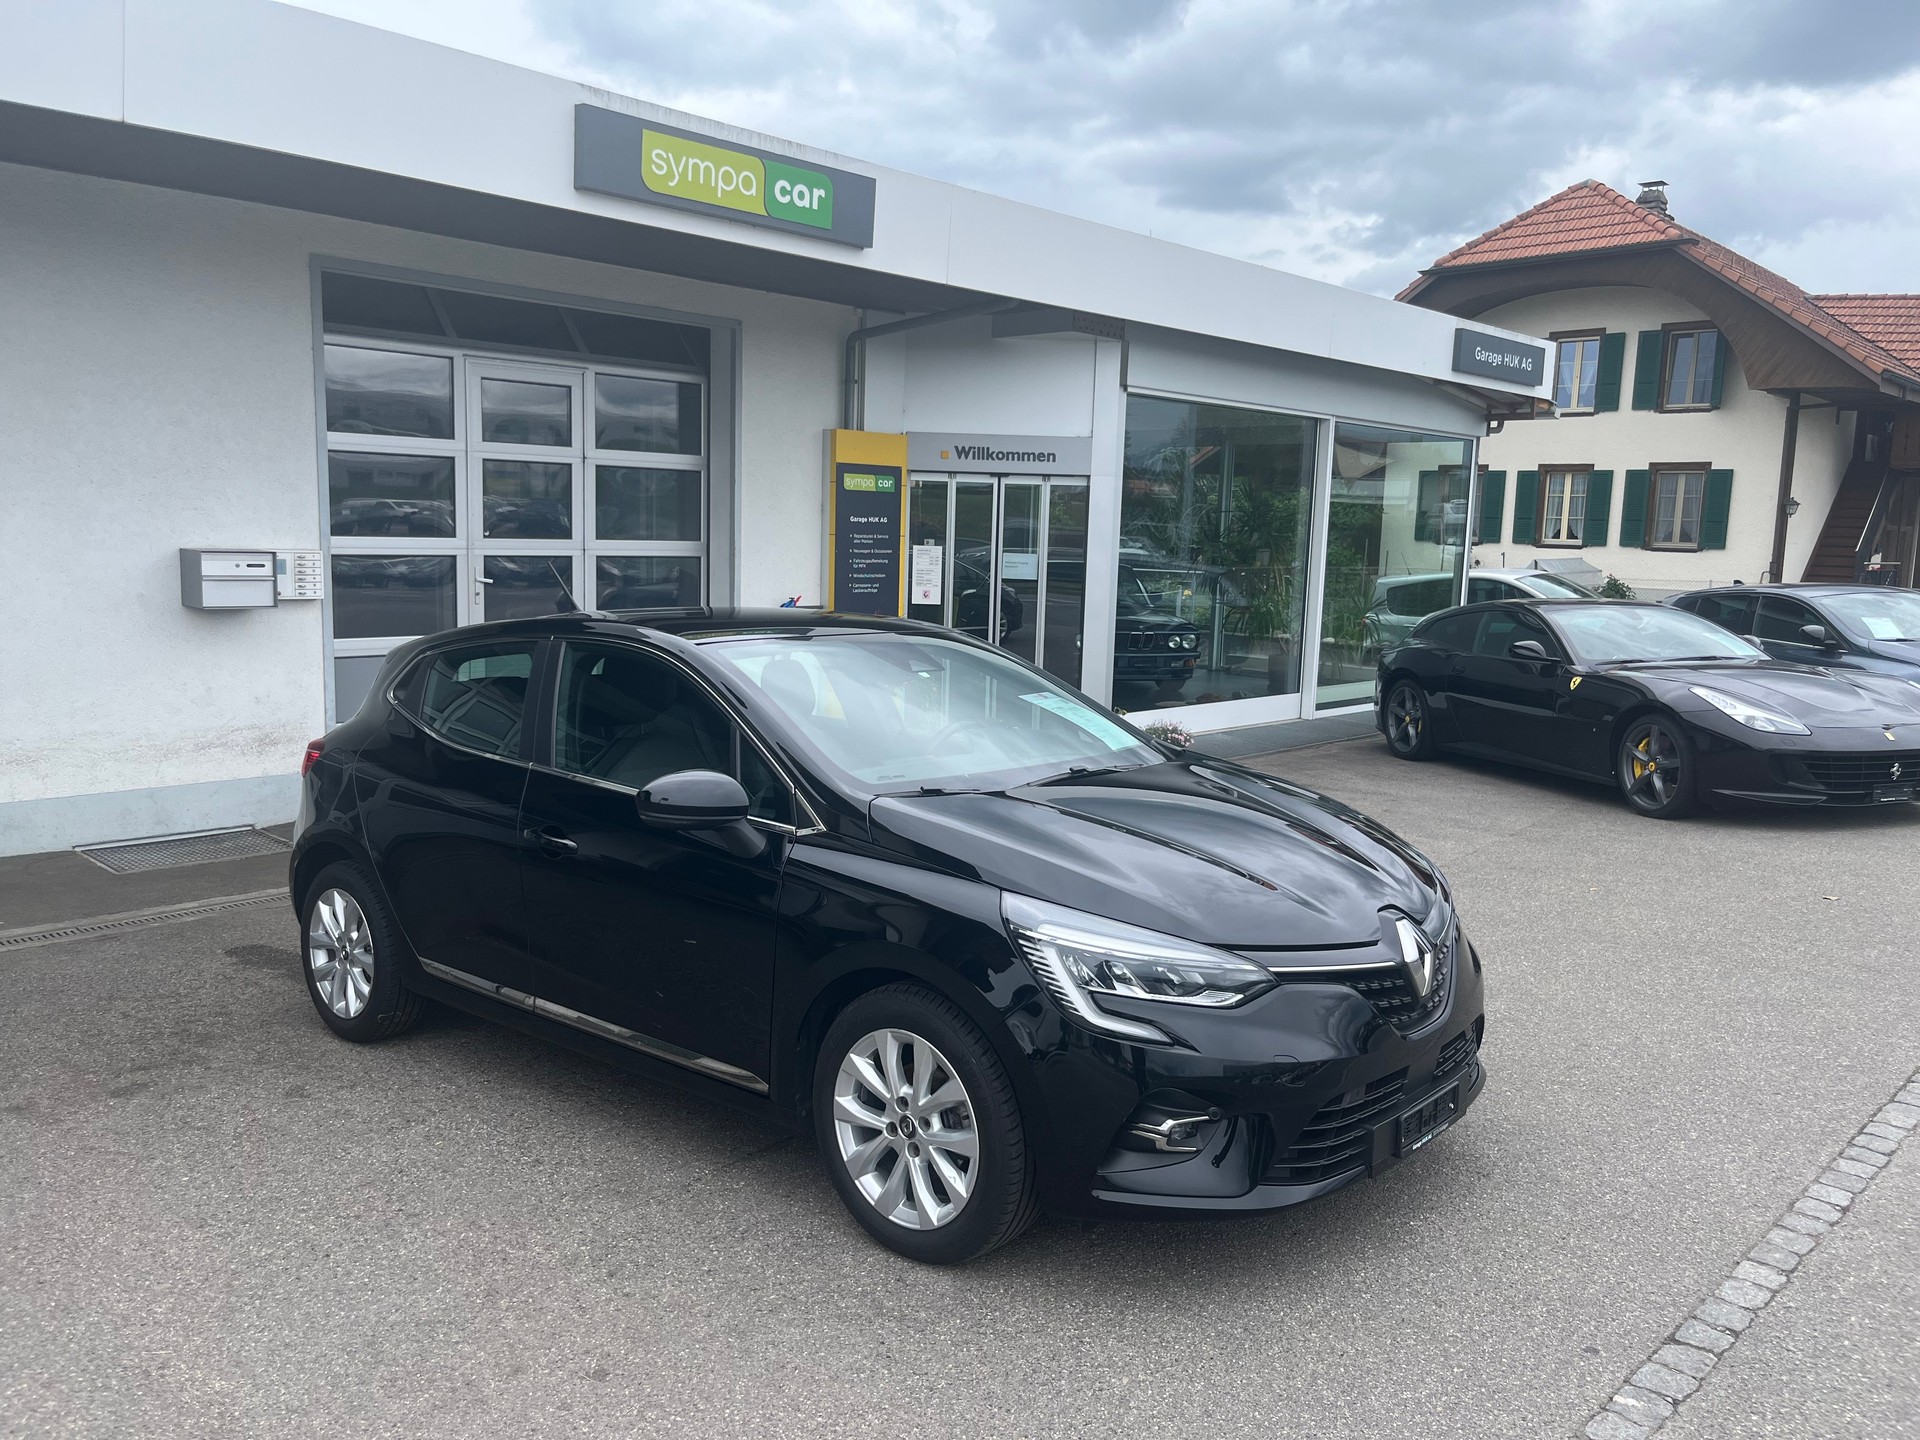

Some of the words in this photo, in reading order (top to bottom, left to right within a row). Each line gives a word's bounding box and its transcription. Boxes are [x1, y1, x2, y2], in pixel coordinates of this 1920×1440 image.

[651, 149, 757, 198] sympa
[774, 180, 826, 210] car
[1475, 346, 1502, 366] Garage
[1503, 353, 1520, 369] HUK
[1521, 357, 1532, 371] AG
[954, 445, 1057, 463] Willkommen
[845, 477, 874, 489] sympa
[877, 479, 893, 488] car
[849, 515, 868, 523] Garage
